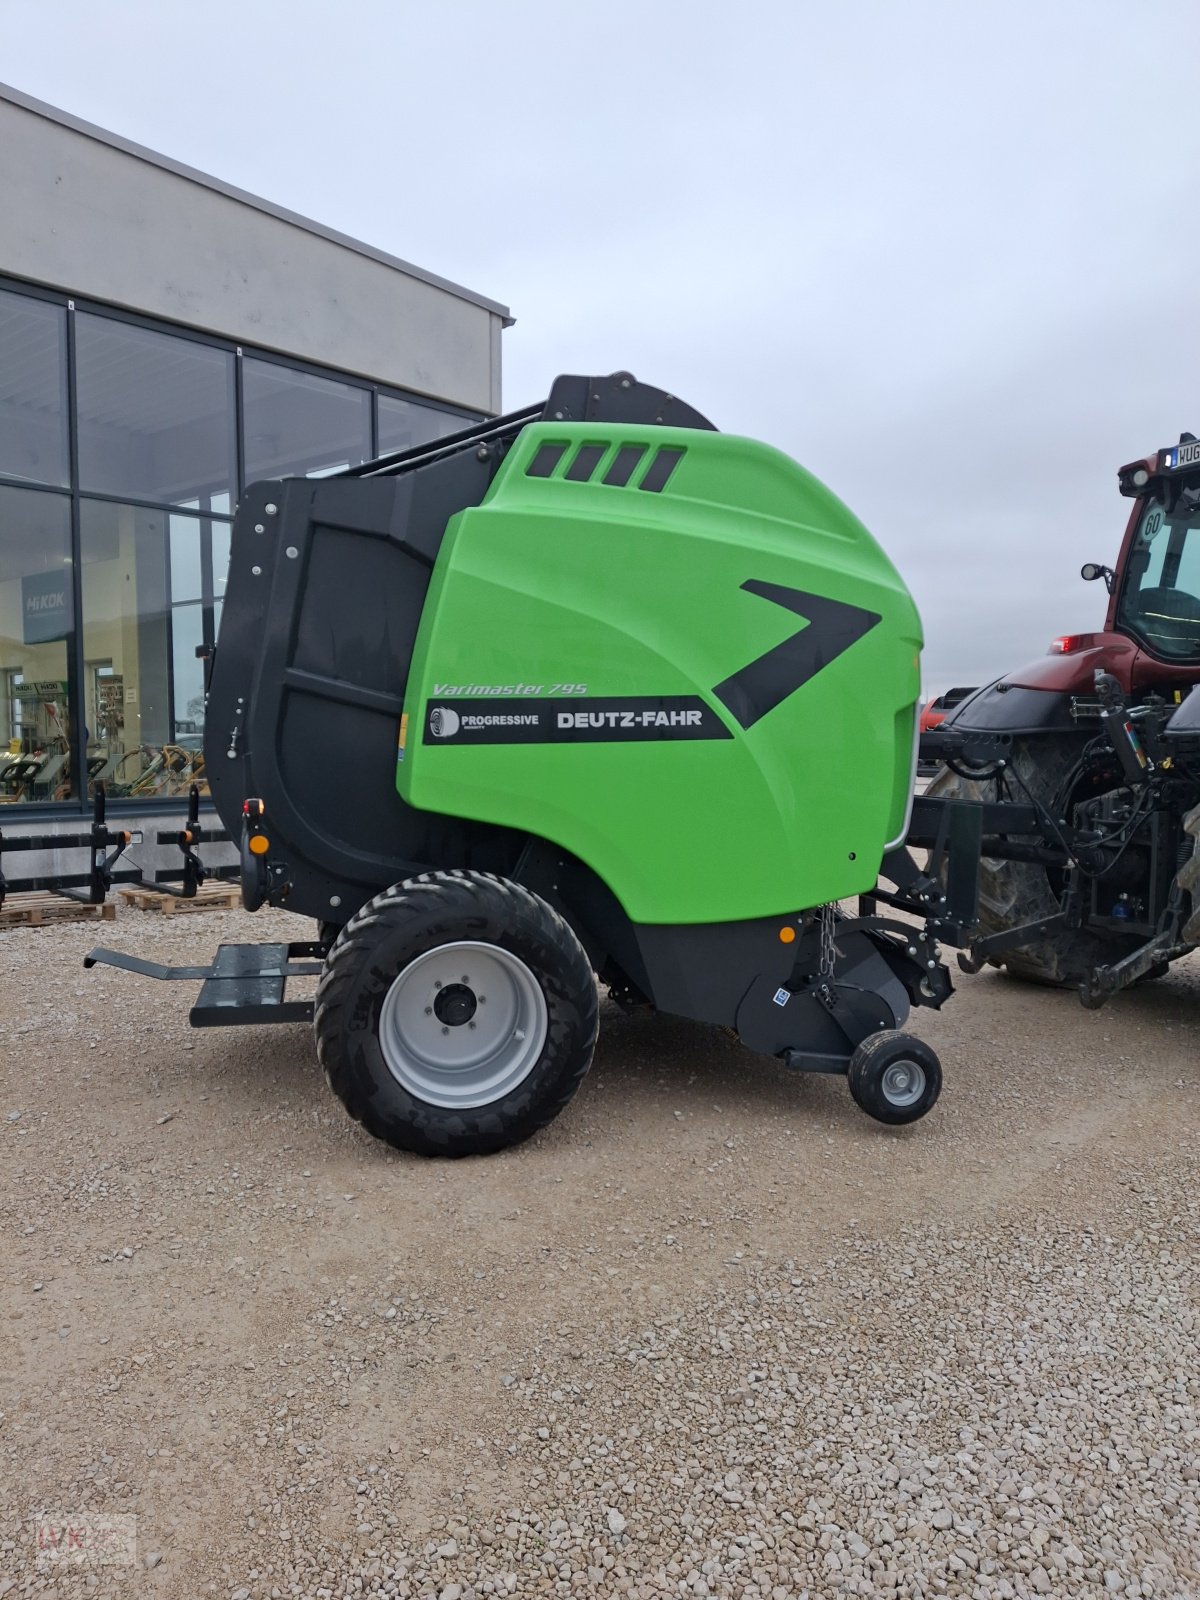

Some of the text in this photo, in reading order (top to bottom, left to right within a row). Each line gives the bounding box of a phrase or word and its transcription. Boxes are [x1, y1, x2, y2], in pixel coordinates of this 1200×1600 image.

[1179, 445, 1200, 464] WUG
[1145, 513, 1161, 535] 60
[432, 683, 588, 696] Varimaster 795
[461, 715, 539, 726] PROGRESSIVE
[557, 710, 703, 729] DEUTZ-FAHR
